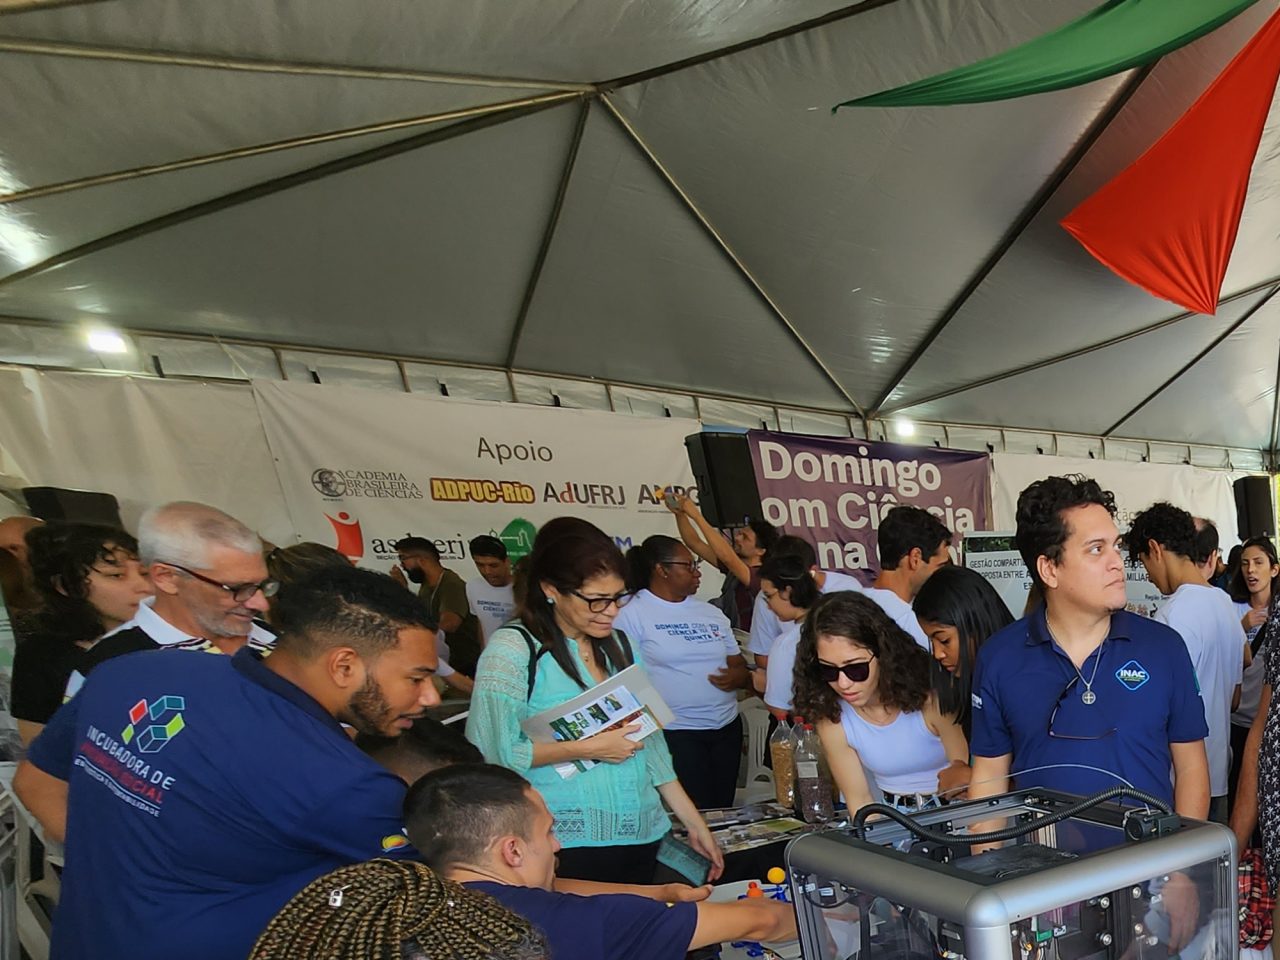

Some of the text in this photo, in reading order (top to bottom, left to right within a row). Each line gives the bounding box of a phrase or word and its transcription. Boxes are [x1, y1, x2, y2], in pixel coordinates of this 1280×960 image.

[477, 436, 553, 465] Apoio
[339, 469, 407, 482] ACADEMIA
[758, 441, 942, 498] Domingo
[345, 487, 362, 498] DE
[346, 479, 419, 492] BRASILEIRA
[430, 477, 536, 504] ADPUC-Rio
[543, 481, 626, 506] AdUFRJ
[817, 539, 869, 570] na
[969, 558, 992, 568] GESTÃO
[1003, 570, 1025, 579] ENTRE
[1120, 669, 1146, 678] INAC
[86, 725, 151, 779] INCUBADORA
[150, 770, 177, 791] DE
